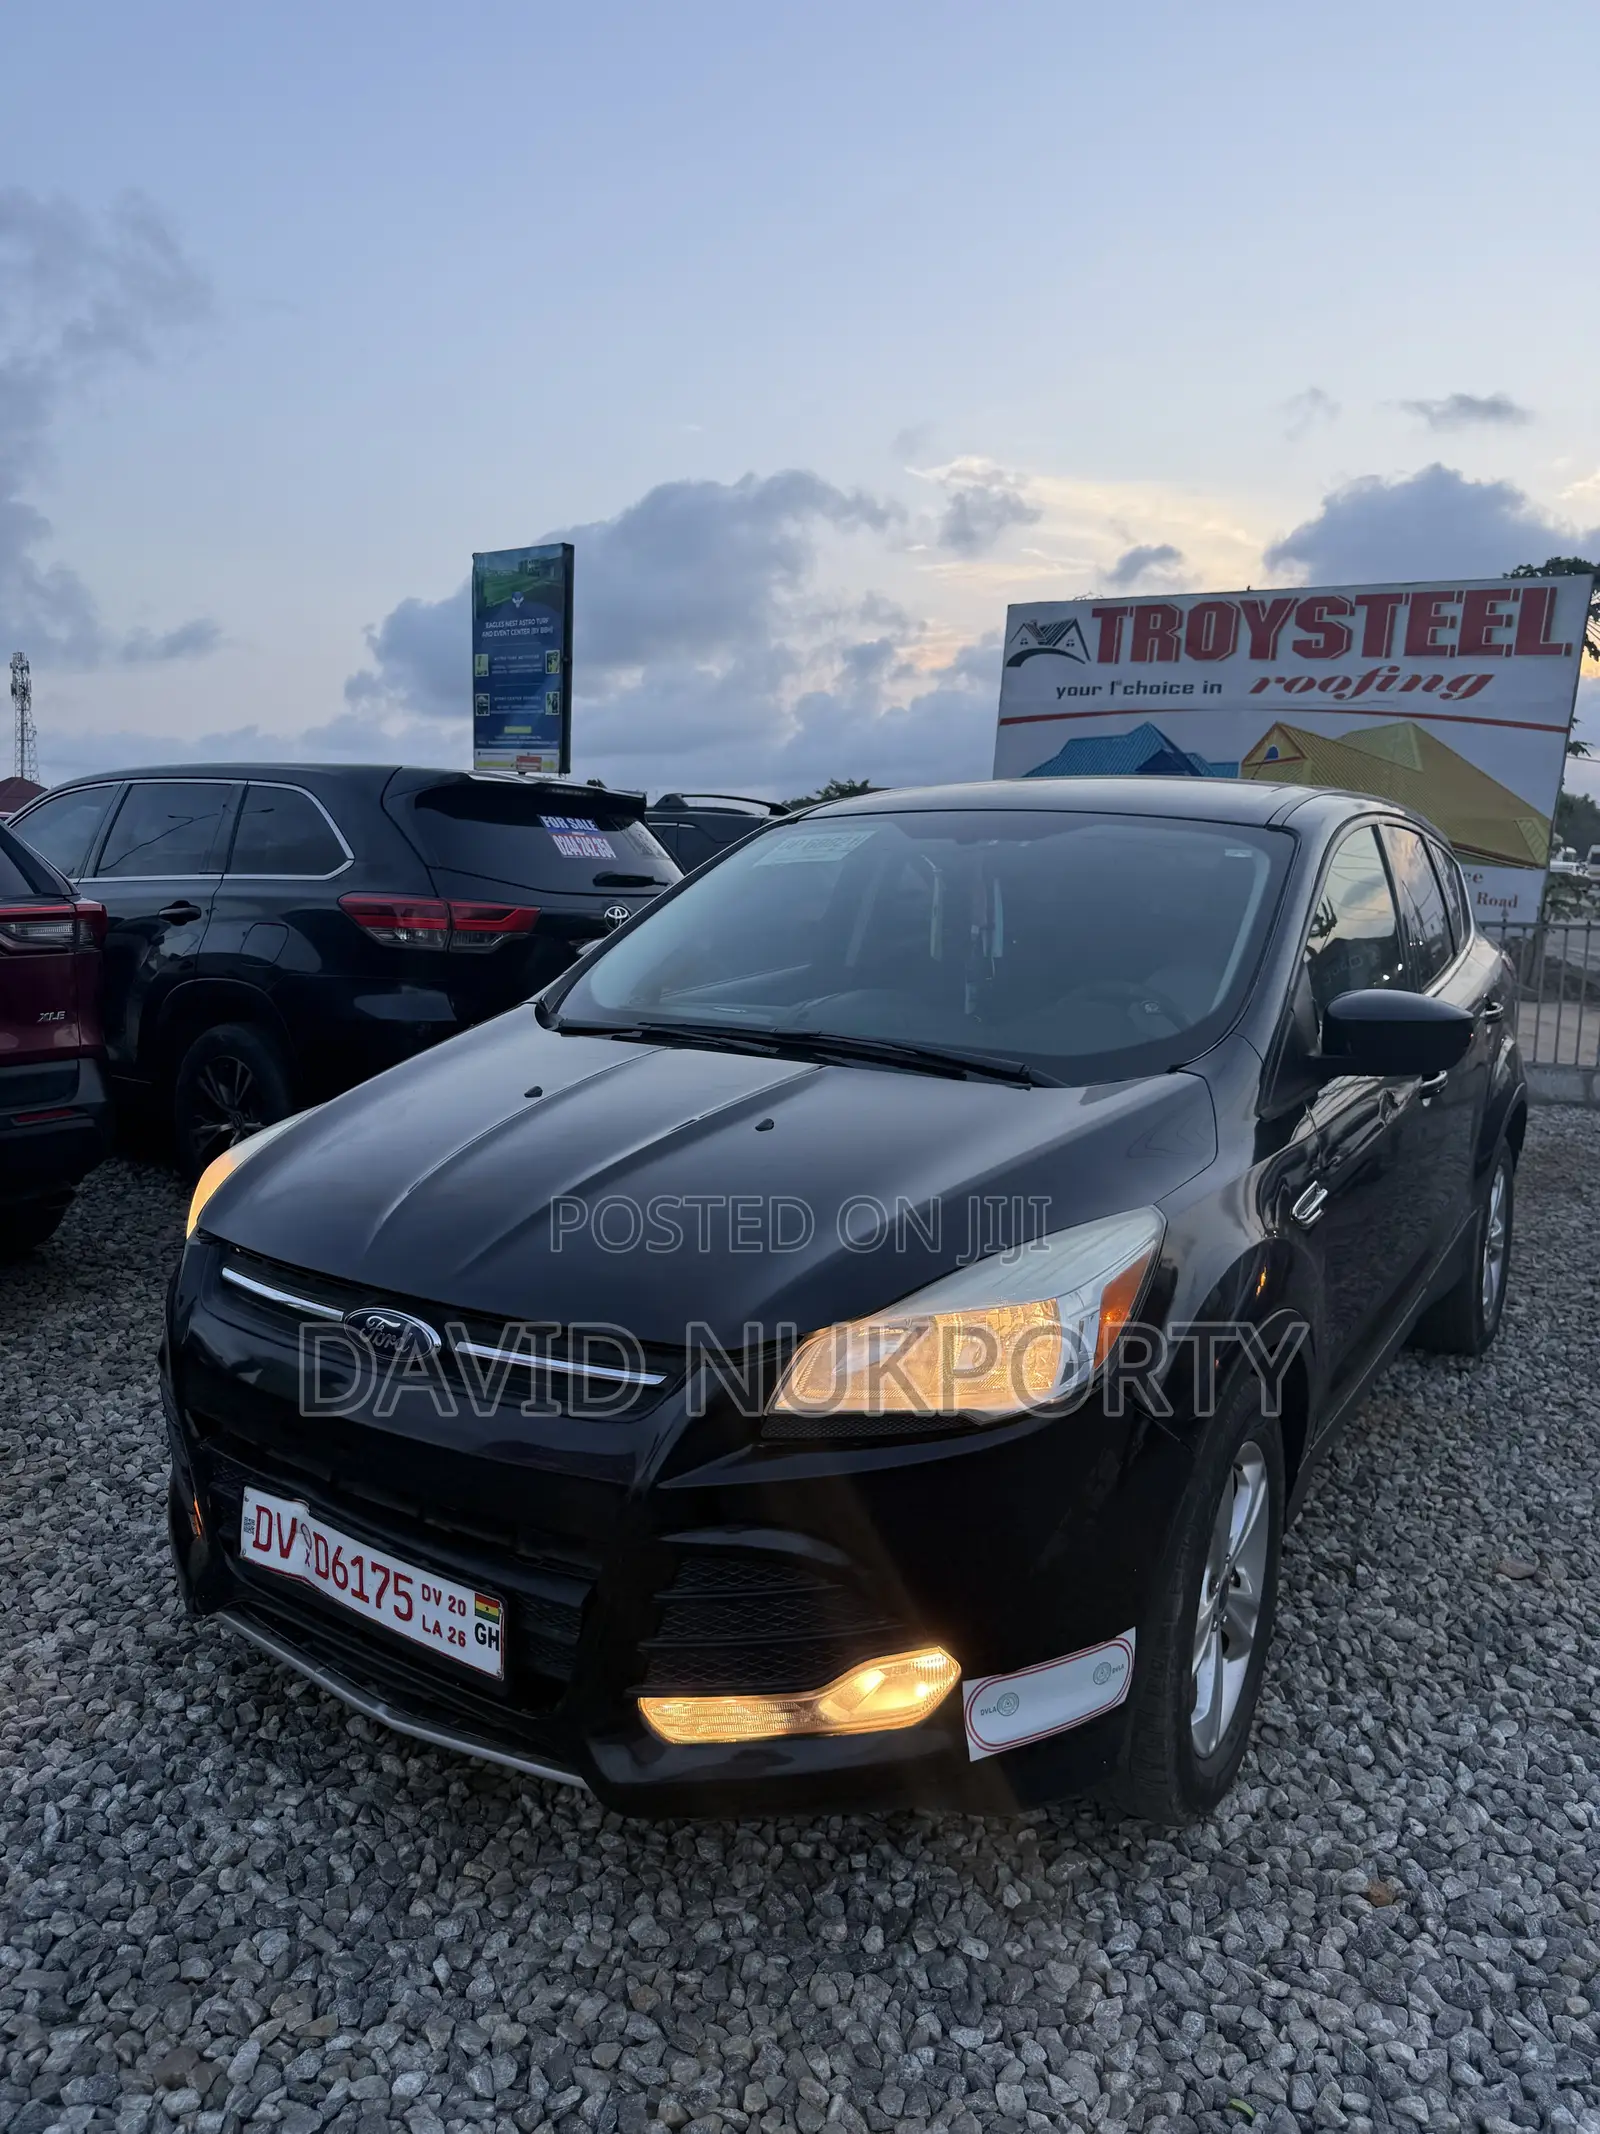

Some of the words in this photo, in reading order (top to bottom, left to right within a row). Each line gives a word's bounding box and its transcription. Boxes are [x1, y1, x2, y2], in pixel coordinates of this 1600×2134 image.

[1091, 586, 1573, 665] TROYSTEEL
[1056, 685, 1102, 699] your
[1123, 680, 1194, 695] choice
[1202, 680, 1222, 694] in
[1248, 665, 1495, 701] roofing
[540, 815, 570, 828] FOR
[569, 818, 599, 831] SALE
[1477, 891, 1519, 909] Road
[37, 1011, 65, 1022] XLE
[360, 1315, 413, 1353] Ford
[421, 1583, 443, 1607] DV
[447, 1595, 467, 1617] 20
[421, 1614, 443, 1639] LA
[447, 1625, 467, 1648] 26
[474, 1622, 501, 1652] GH
[1112, 1664, 1125, 1674] DVLA
[980, 1706, 997, 1716] DVLA
